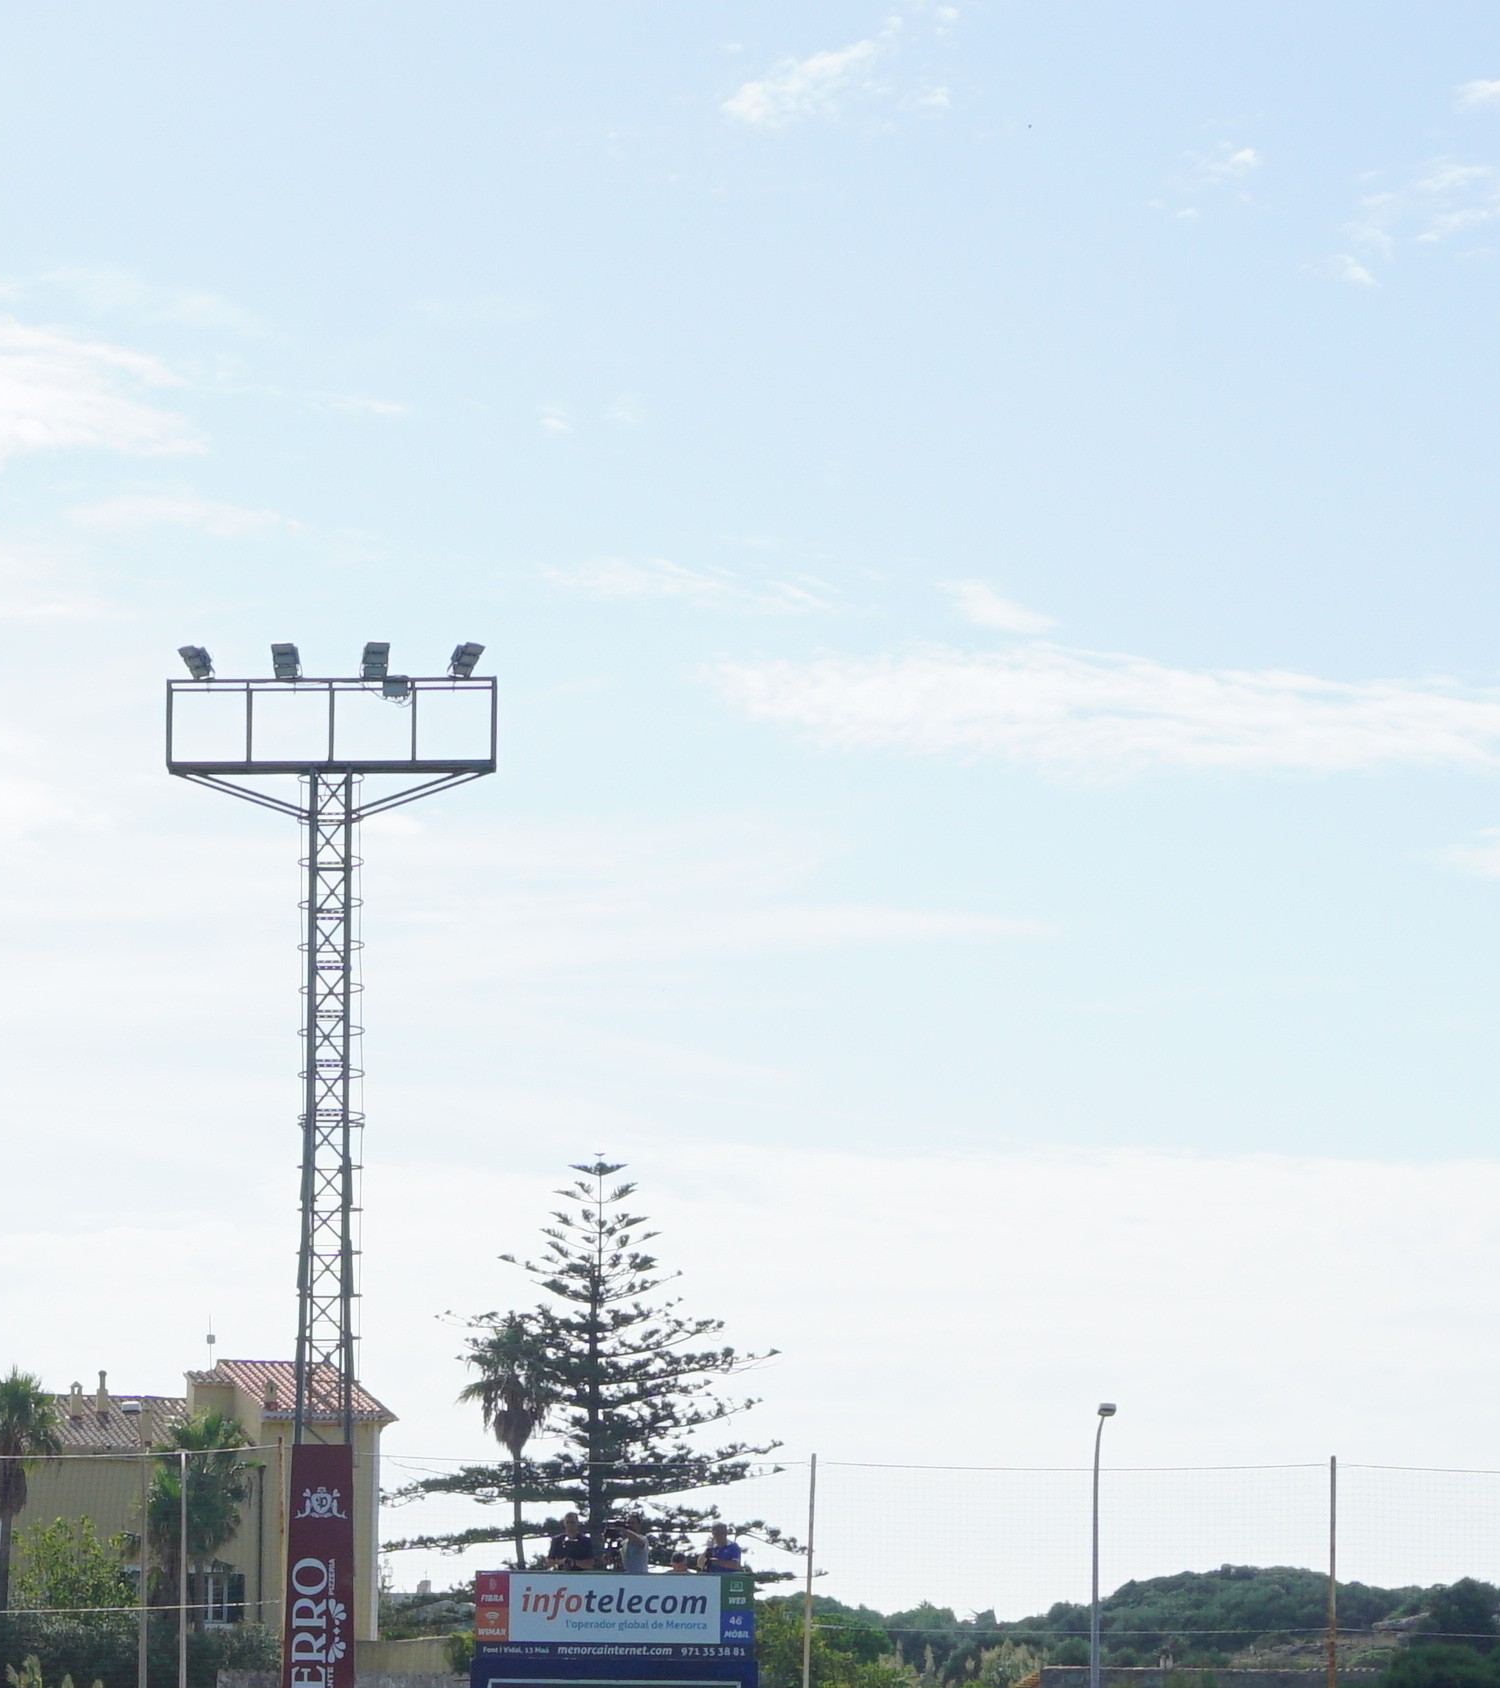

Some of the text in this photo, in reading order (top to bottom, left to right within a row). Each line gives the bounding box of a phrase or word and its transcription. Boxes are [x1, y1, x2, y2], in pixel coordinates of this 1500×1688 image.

[328, 1558, 336, 1596] PIZZERIA
[522, 1586, 708, 1620] infotelecom
[565, 1619, 708, 1632] l'operador global de Menorca
[557, 1645, 673, 1657] menorcainternet.com
[680, 1646, 700, 1657] 971
[702, 1647, 716, 1657] 35
[733, 1647, 746, 1657] 81
